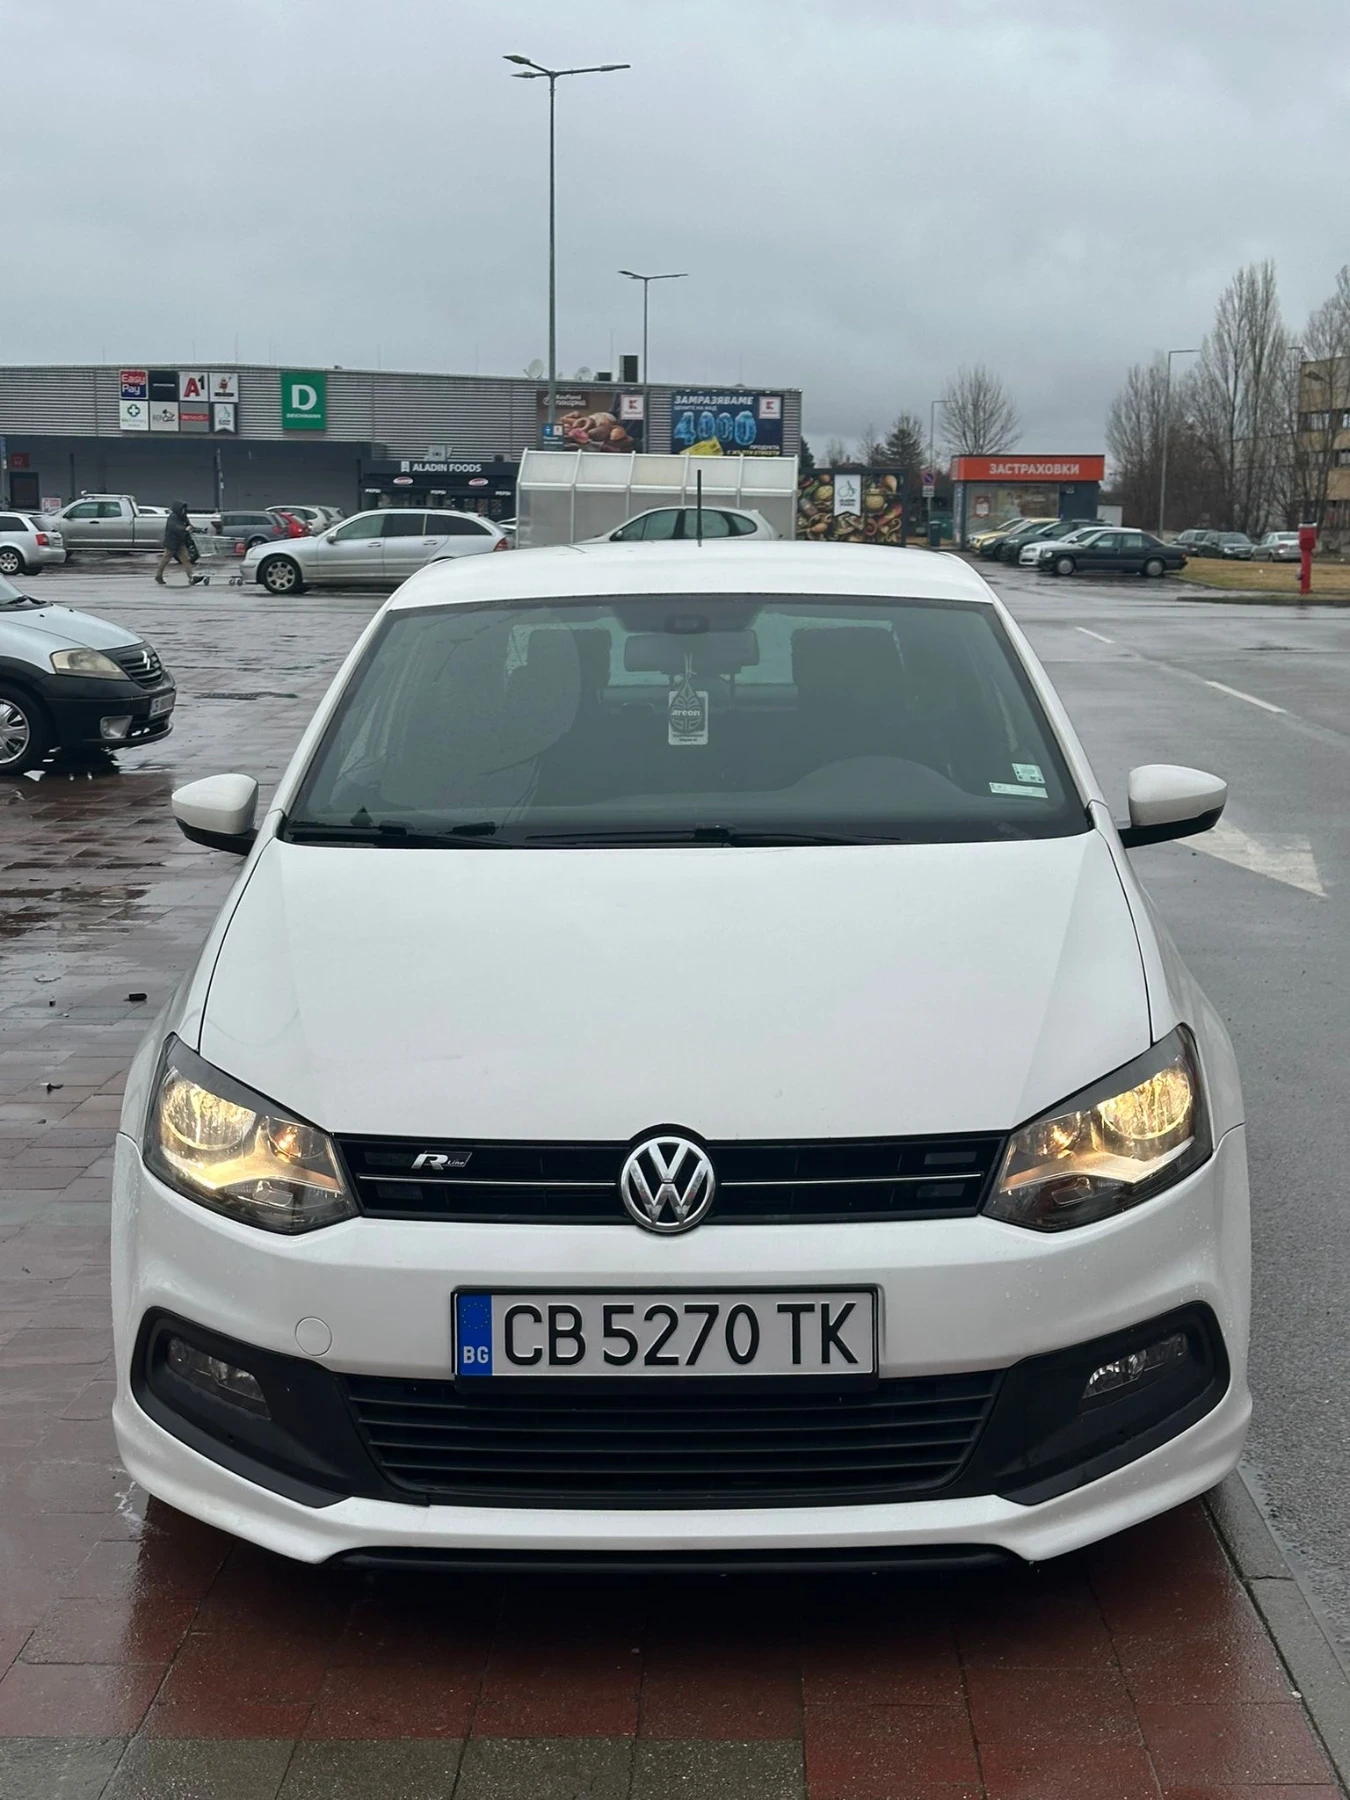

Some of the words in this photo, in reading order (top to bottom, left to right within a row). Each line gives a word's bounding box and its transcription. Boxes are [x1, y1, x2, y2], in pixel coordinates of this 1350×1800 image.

[122, 374, 146, 385] Easy
[184, 375, 205, 397] A1
[122, 384, 141, 395] Pay
[292, 384, 317, 410] D
[674, 395, 754, 405] ЗАМРАЗЯВАМЕ
[674, 411, 757, 446] 4000
[412, 463, 448, 472] ALADIN
[449, 463, 482, 472] FOODS
[989, 463, 1080, 475] ЗАСТРАХОВКИ
[671, 709, 701, 717] areon
[411, 1153, 449, 1170] R
[504, 1302, 586, 1366] CB
[602, 1302, 760, 1366] 5270
[776, 1302, 859, 1365] TK
[463, 1345, 490, 1364] BG
